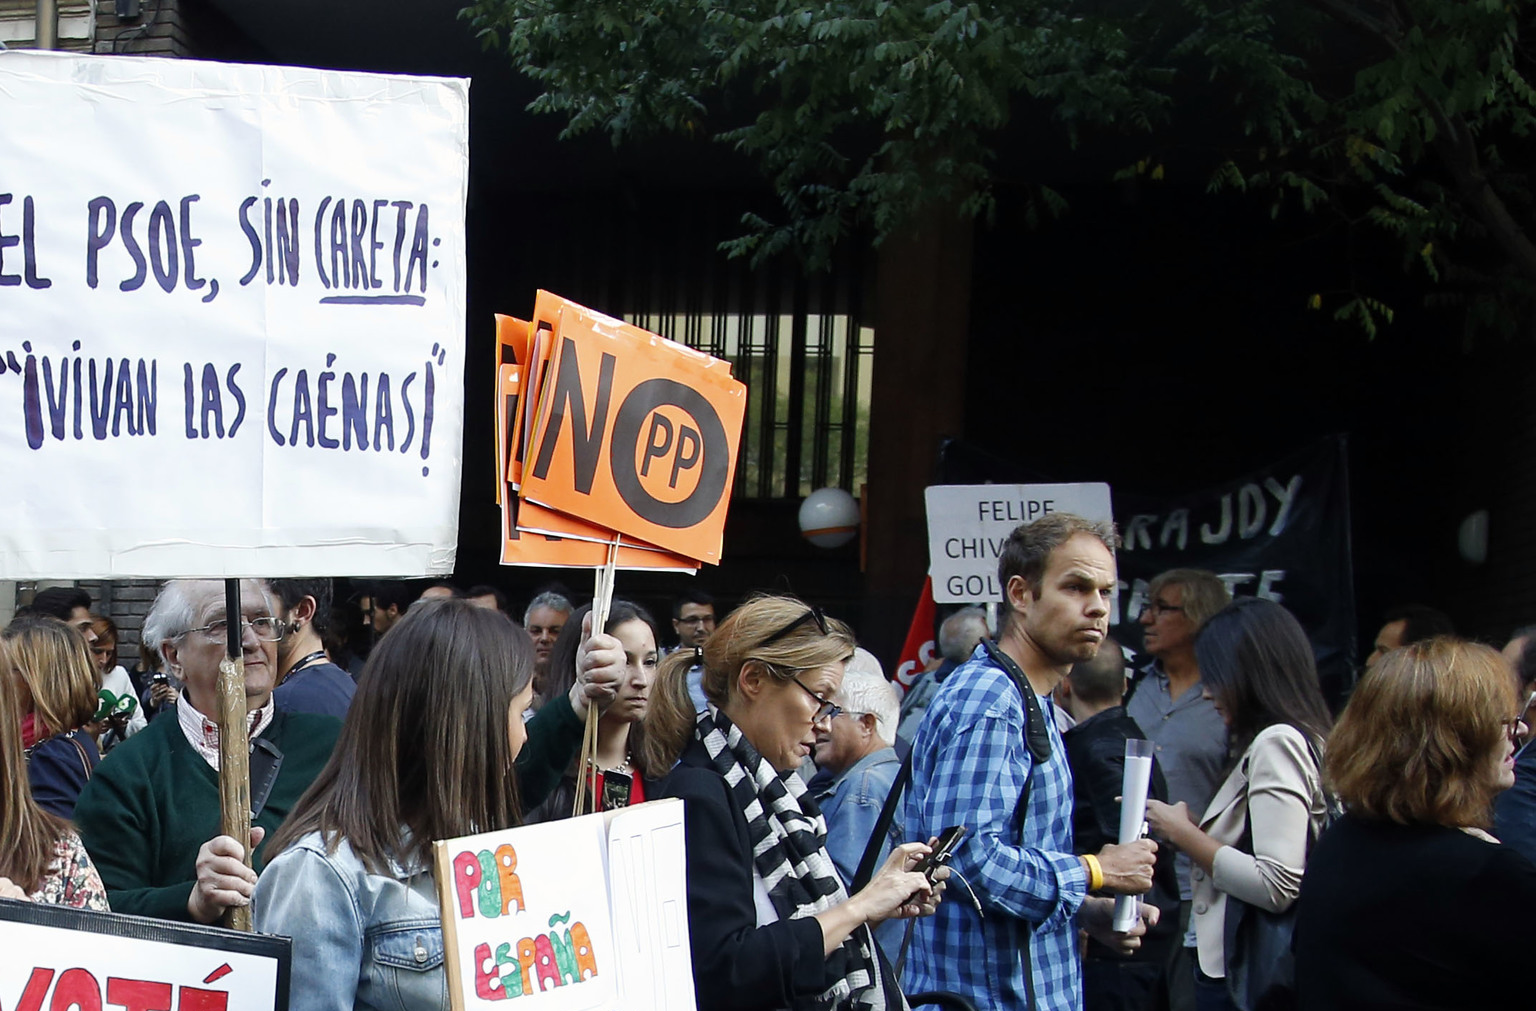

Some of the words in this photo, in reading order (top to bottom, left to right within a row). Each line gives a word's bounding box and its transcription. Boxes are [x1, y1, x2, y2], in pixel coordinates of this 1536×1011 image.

[85, 194, 220, 303] PSOE,
[314, 196, 442, 293] CARETA:
[183, 363, 247, 440] LAS
[532, 337, 730, 529] NO
[640, 412, 702, 489] PP
[453, 843, 526, 919] POR
[474, 910, 598, 1001] ESPAÑA
